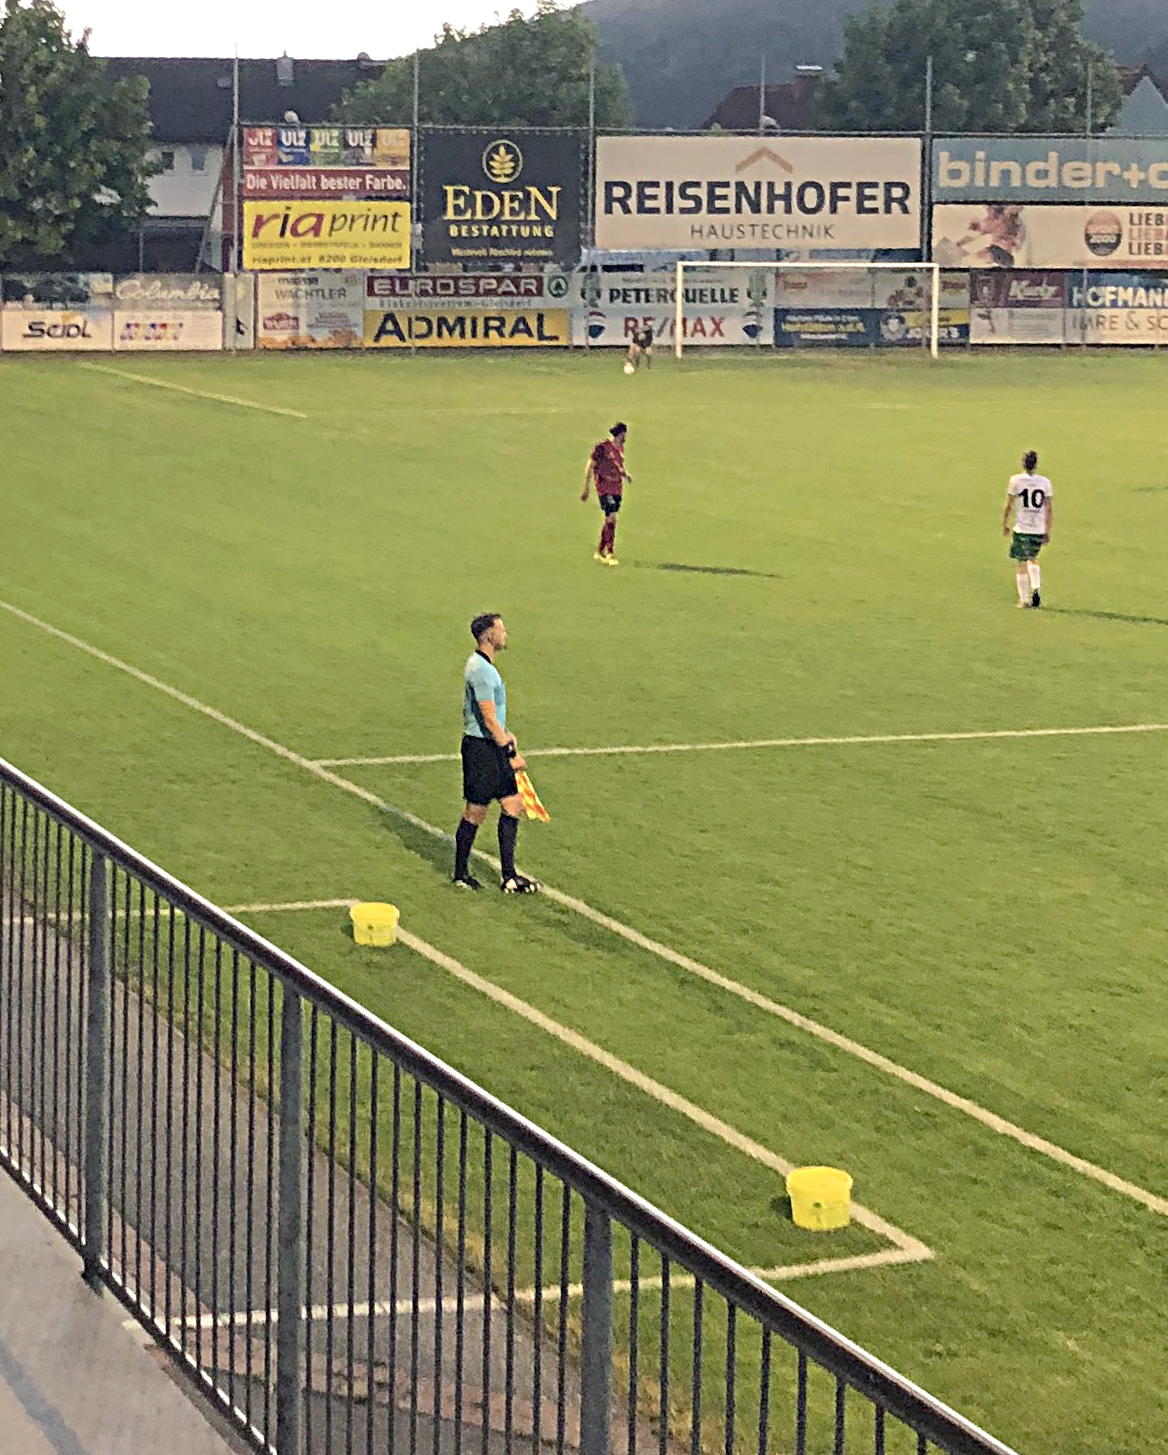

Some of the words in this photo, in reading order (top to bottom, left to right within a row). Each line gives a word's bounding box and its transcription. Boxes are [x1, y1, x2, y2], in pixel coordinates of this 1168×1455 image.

[246, 175, 267, 190] Die
[271, 174, 317, 190] Vielfalt
[321, 175, 362, 191] bester
[365, 175, 407, 190] Farbe.
[442, 184, 562, 221] EDEN
[604, 180, 910, 216] REISENHOFER
[449, 225, 554, 238] BESTATTUNG
[690, 223, 835, 240] HAUSTECHNIK
[373, 278, 538, 295] EUROSPAR
[373, 312, 559, 343] ADMIRAL
[1018, 488, 1045, 508] 10
